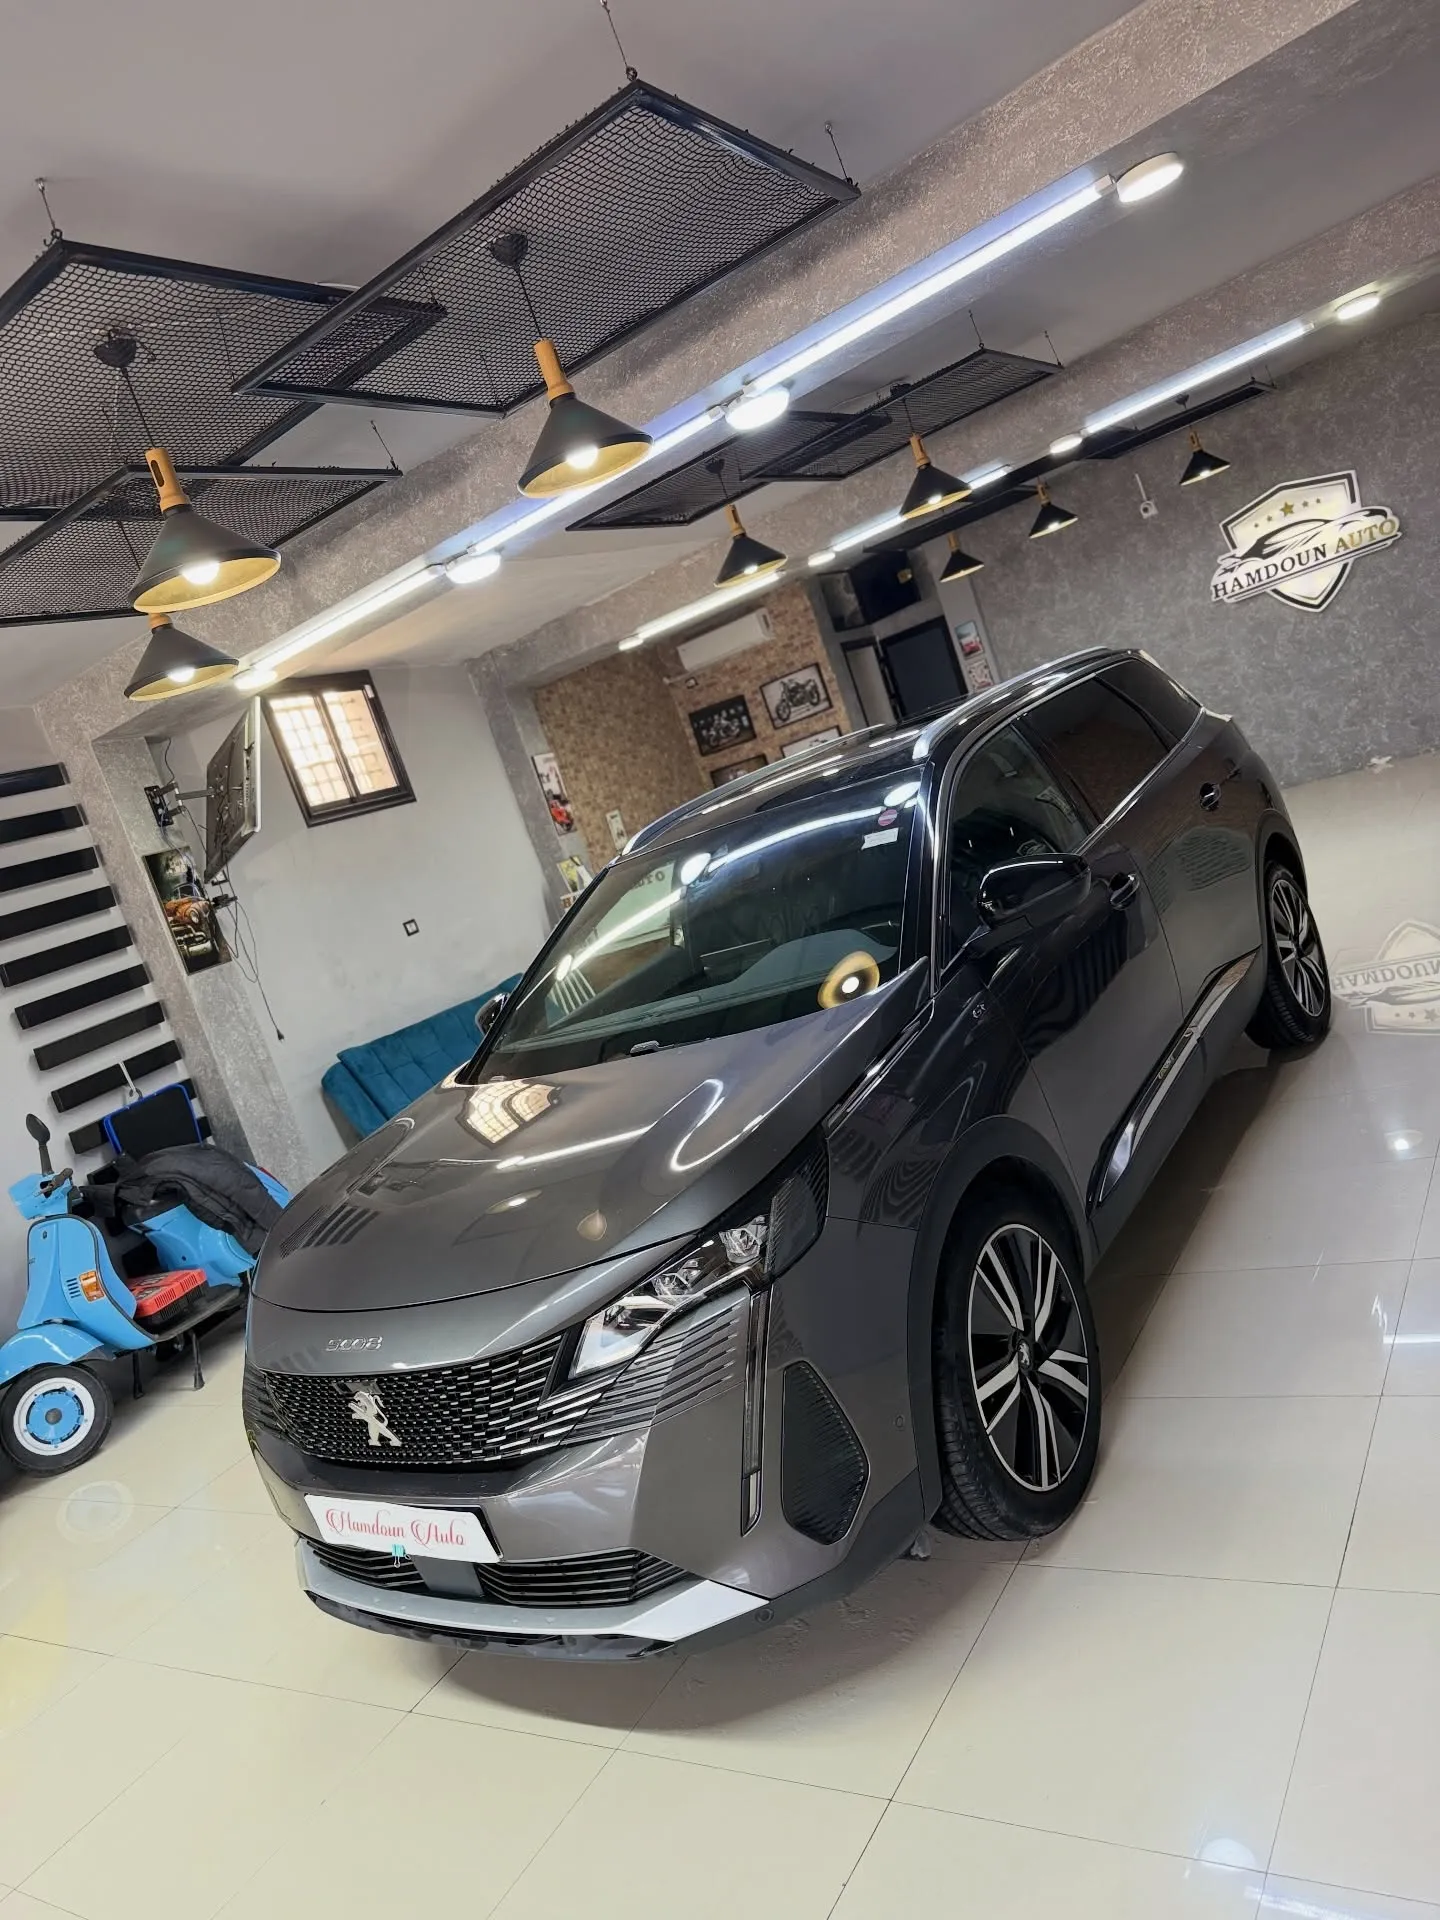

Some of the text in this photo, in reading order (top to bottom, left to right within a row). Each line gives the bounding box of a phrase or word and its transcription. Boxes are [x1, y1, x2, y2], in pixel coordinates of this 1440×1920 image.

[1213, 518, 1396, 598] HAMDOUN AUTO
[326, 1336, 383, 1351] 5008
[326, 1508, 405, 1538] Hamdoun
